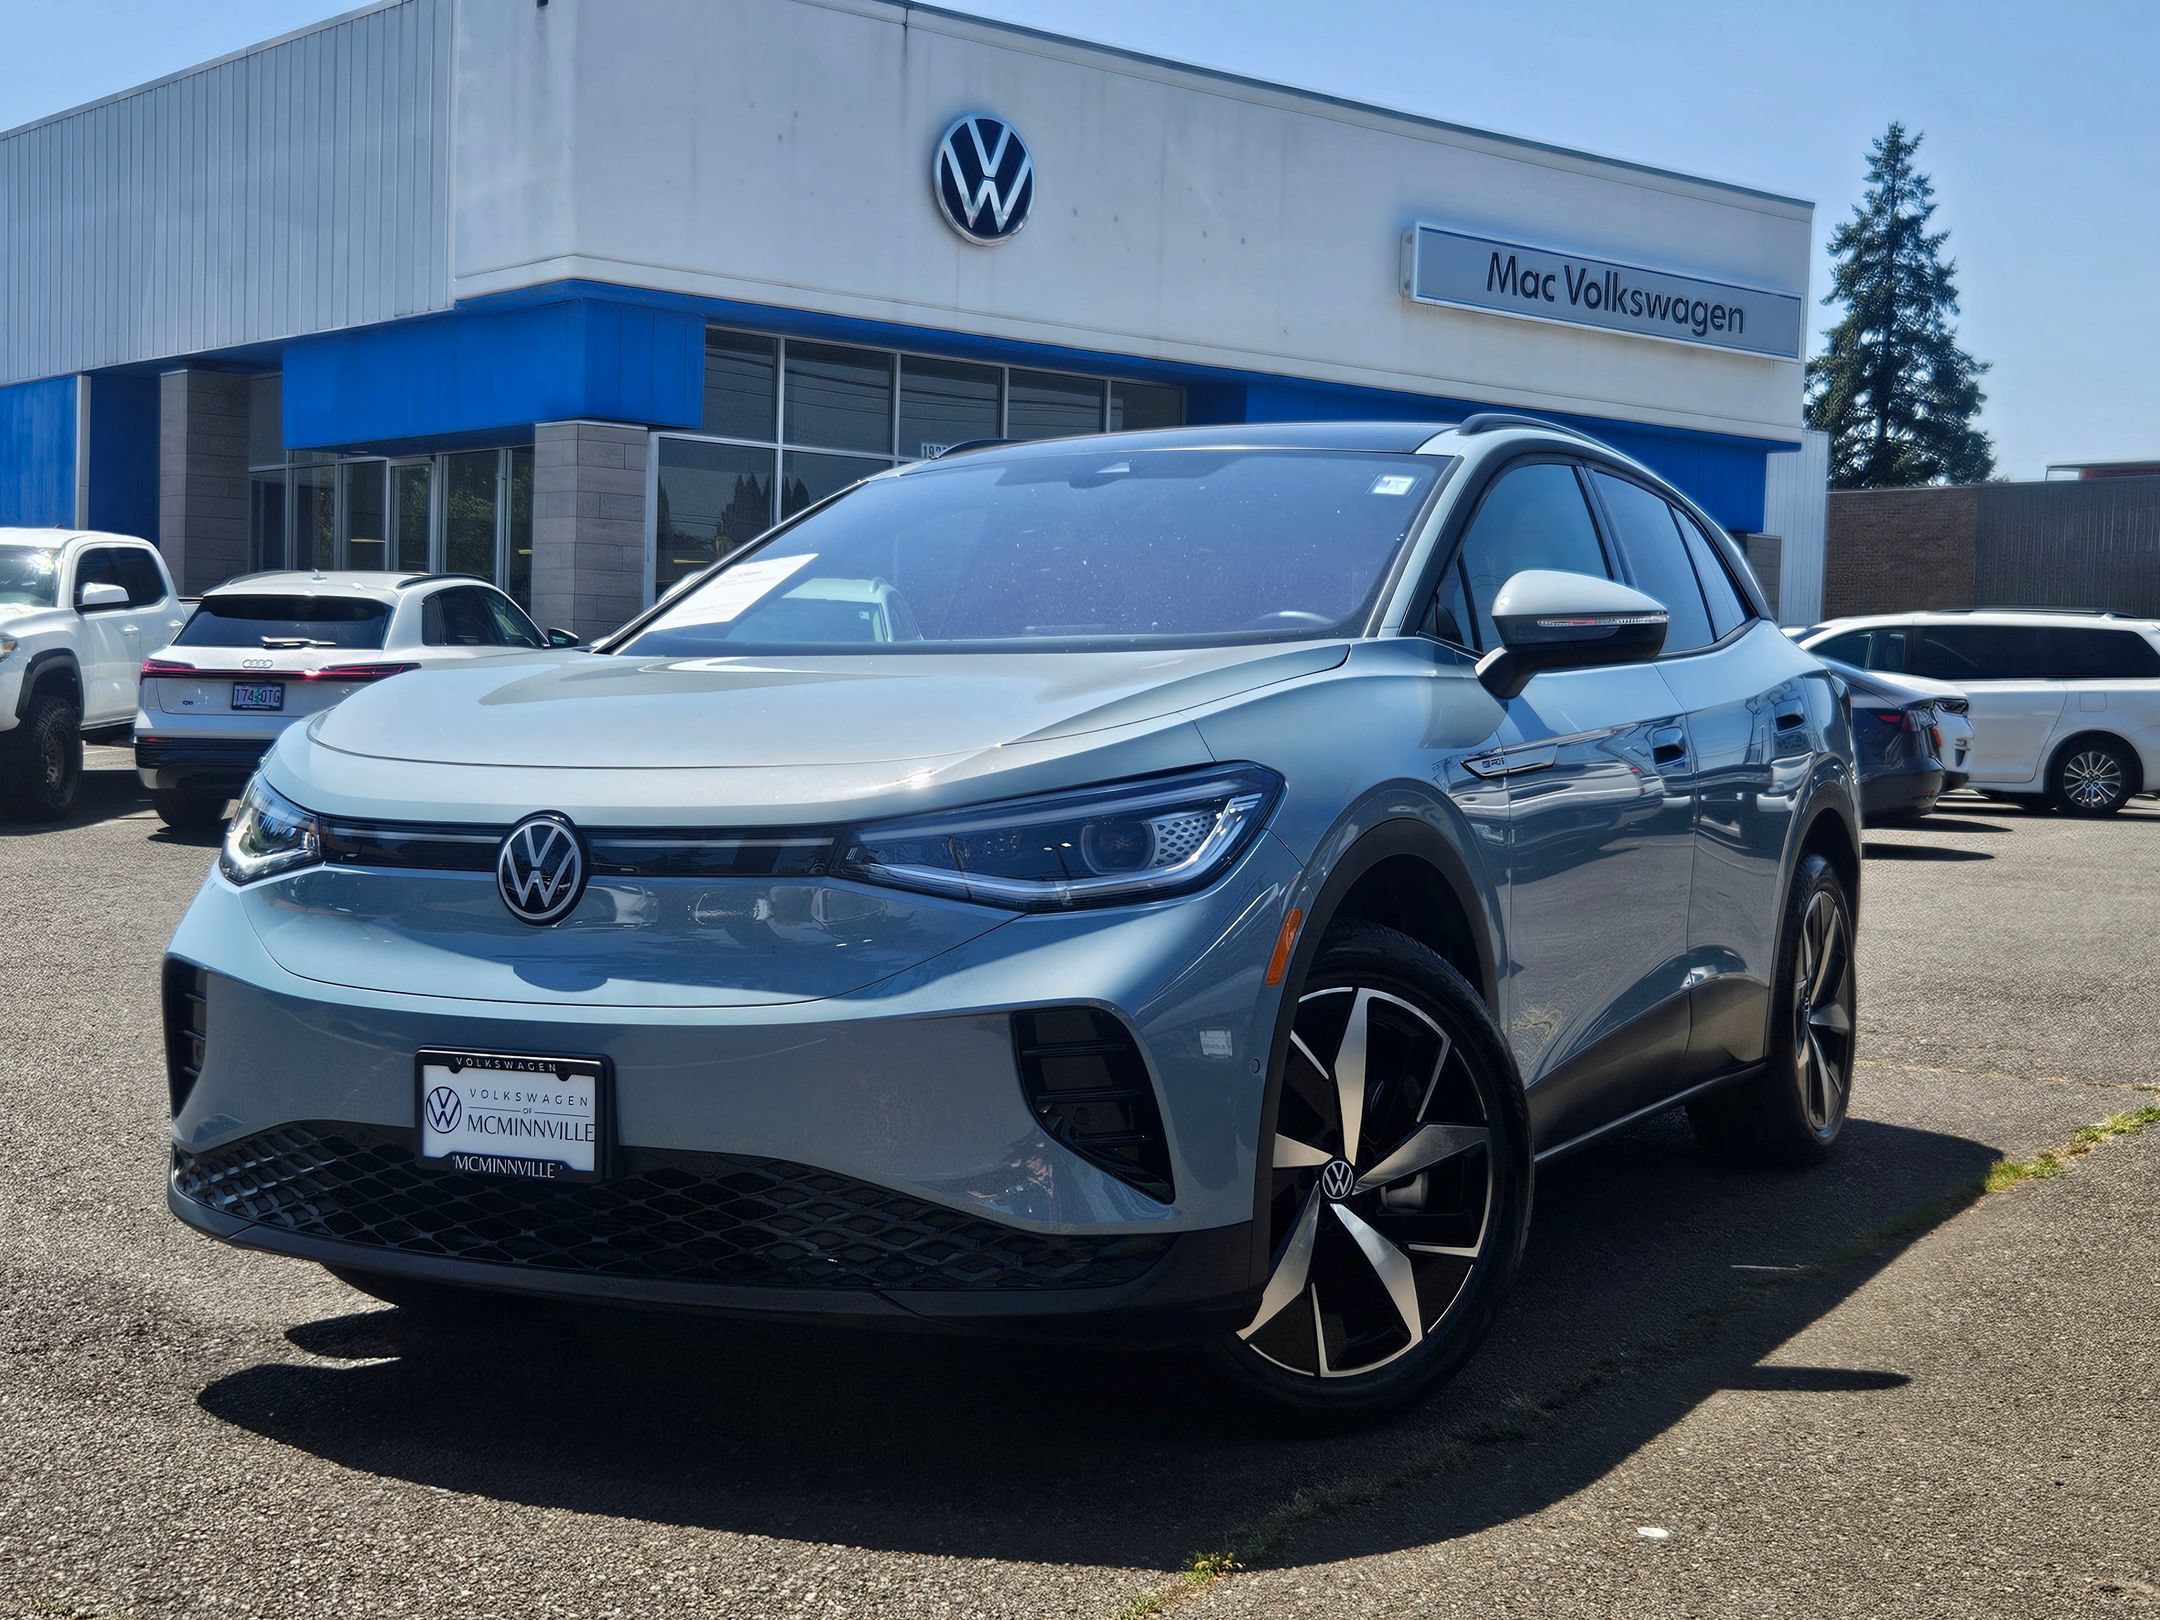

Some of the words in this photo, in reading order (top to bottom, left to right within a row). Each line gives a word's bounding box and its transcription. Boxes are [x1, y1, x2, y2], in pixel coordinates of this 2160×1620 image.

[1487, 251, 1556, 302] Mac
[1563, 265, 1744, 337] Volkswagen
[456, 1057, 556, 1072] VOLKSWAGEN
[469, 1088, 588, 1107] VOLKSWAGEN
[522, 1107, 533, 1115] OF
[467, 1114, 595, 1143] MCMINNVILLE
